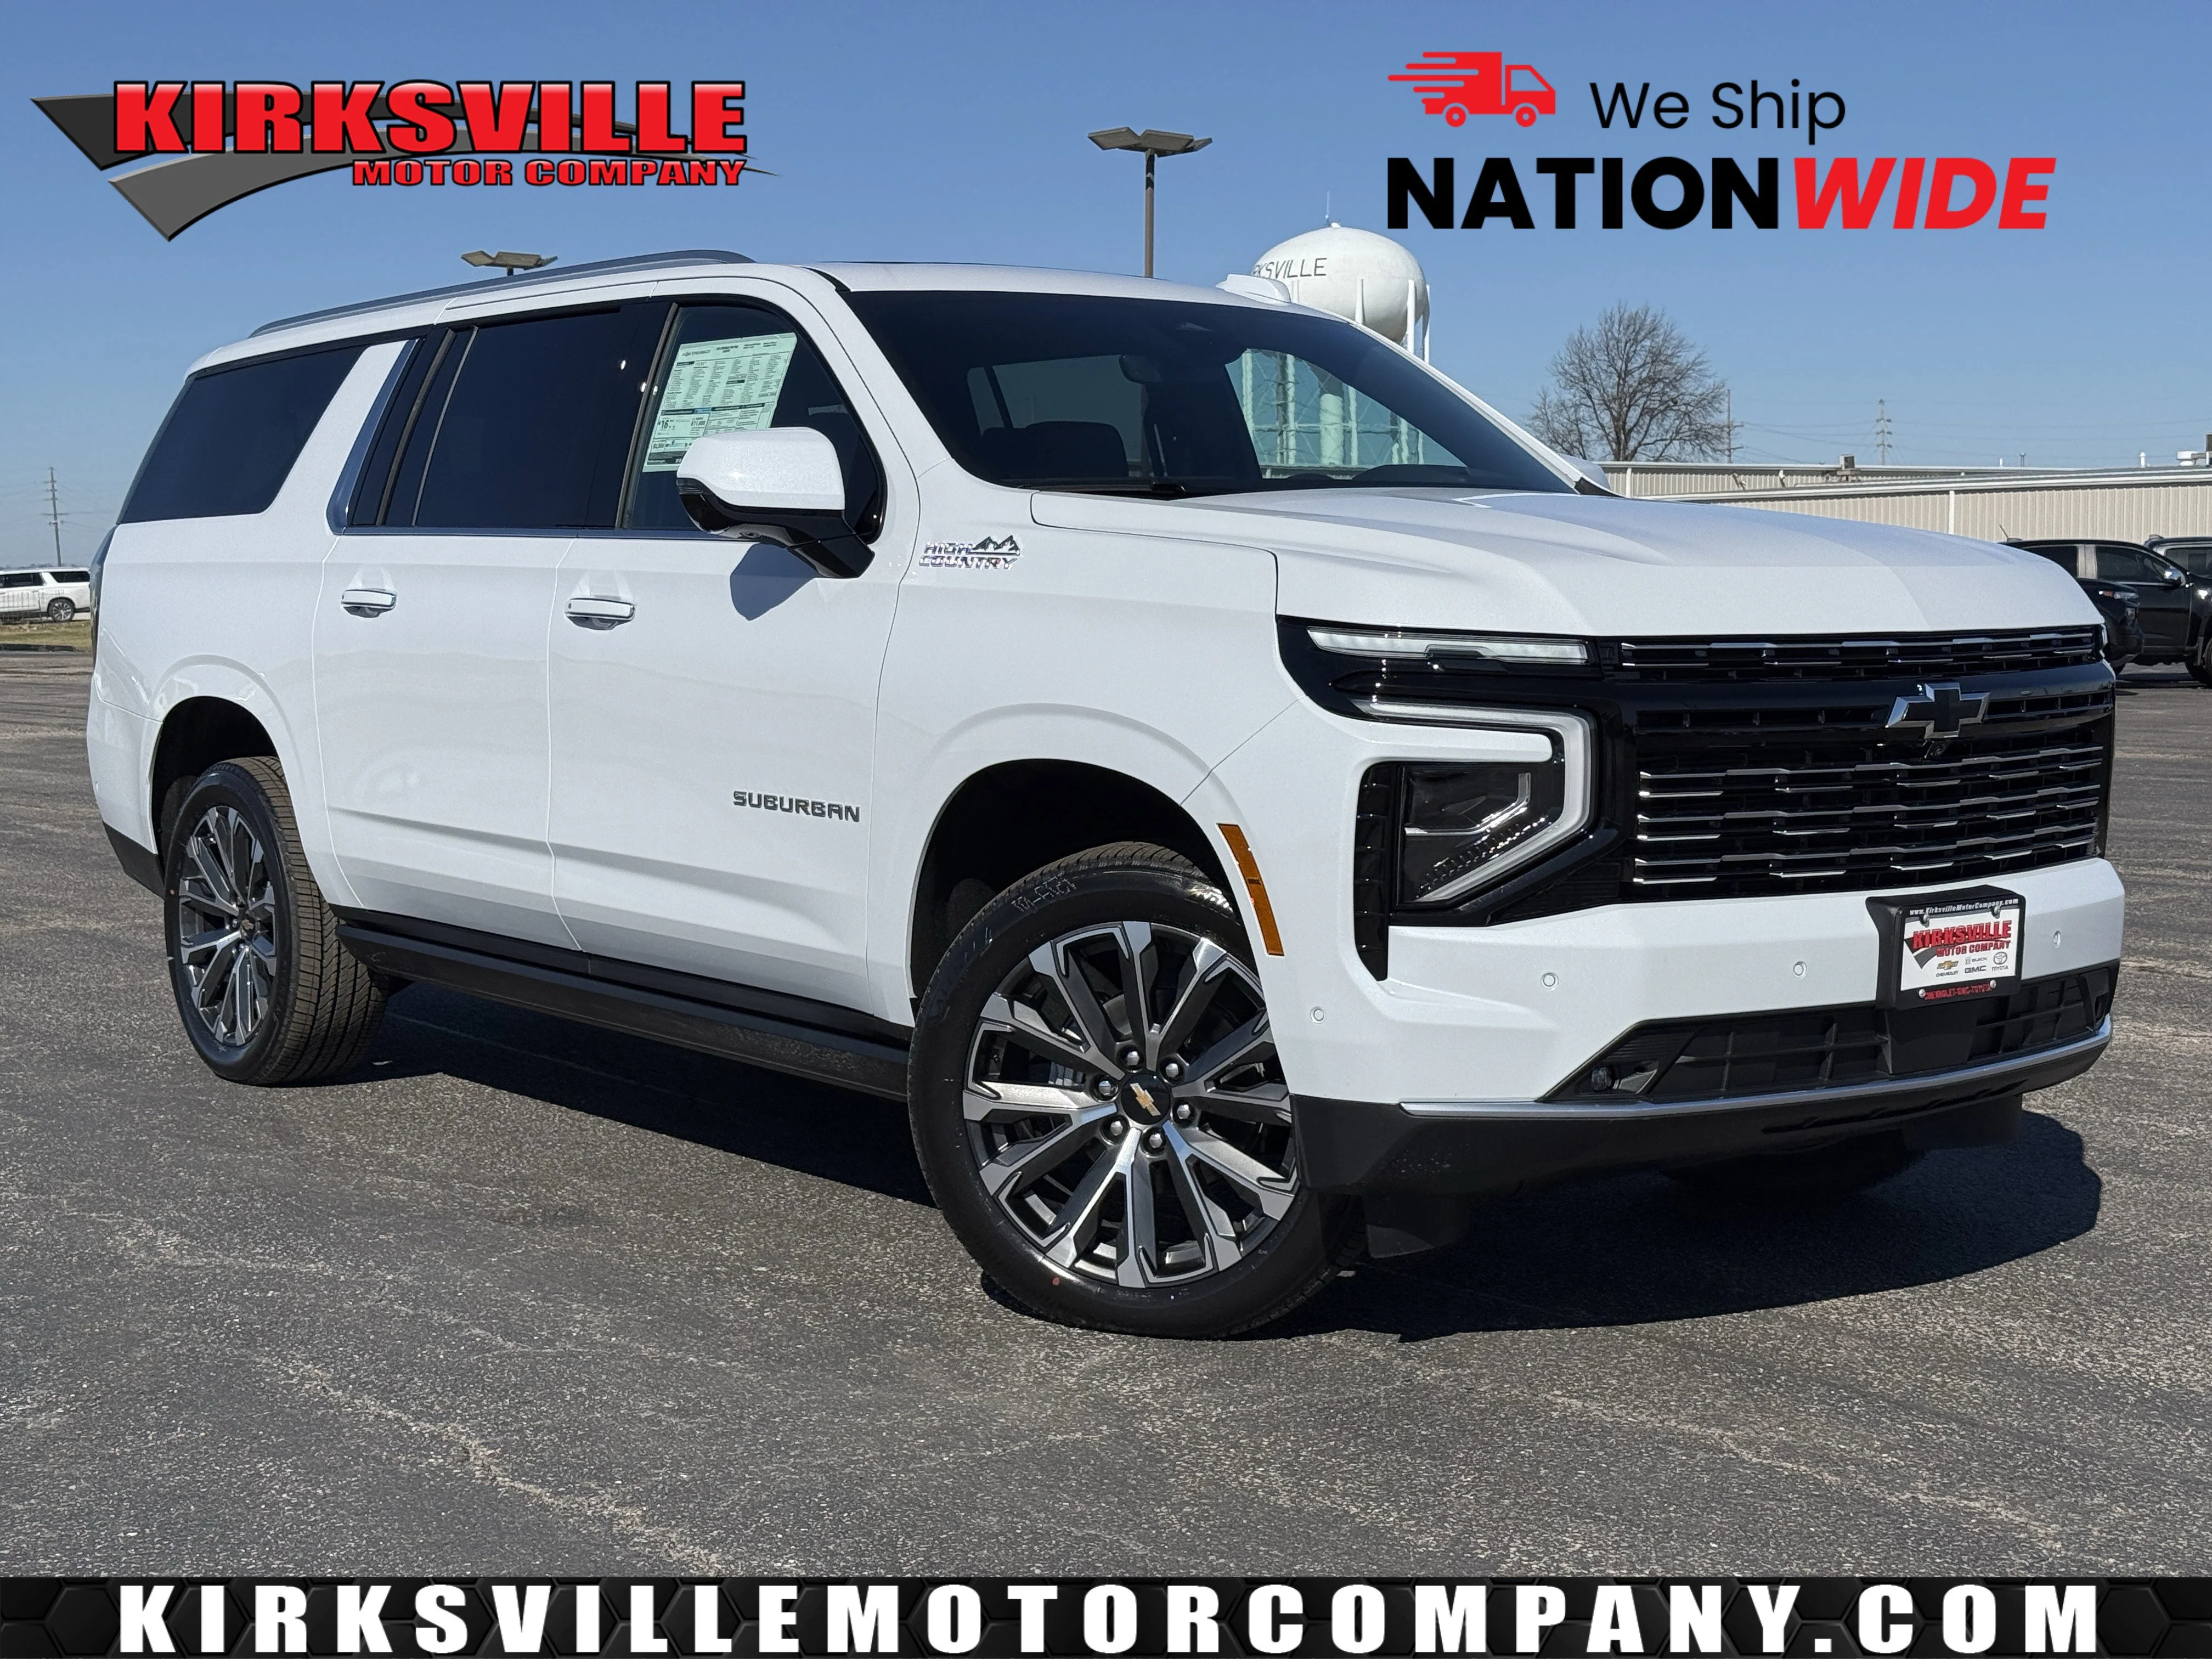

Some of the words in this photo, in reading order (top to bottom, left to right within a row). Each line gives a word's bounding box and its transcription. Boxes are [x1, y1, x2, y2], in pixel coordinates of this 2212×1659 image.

[923, 542, 975, 555] HIGH
[918, 555, 1018, 569] COUNTRY
[733, 791, 860, 822] SUBURBAN
[1912, 919, 2012, 950] KIRKSVILLE
[1936, 945, 1967, 957] MOTOR
[1968, 940, 2011, 953] COMPANY
[1964, 965, 1987, 974] GMC
